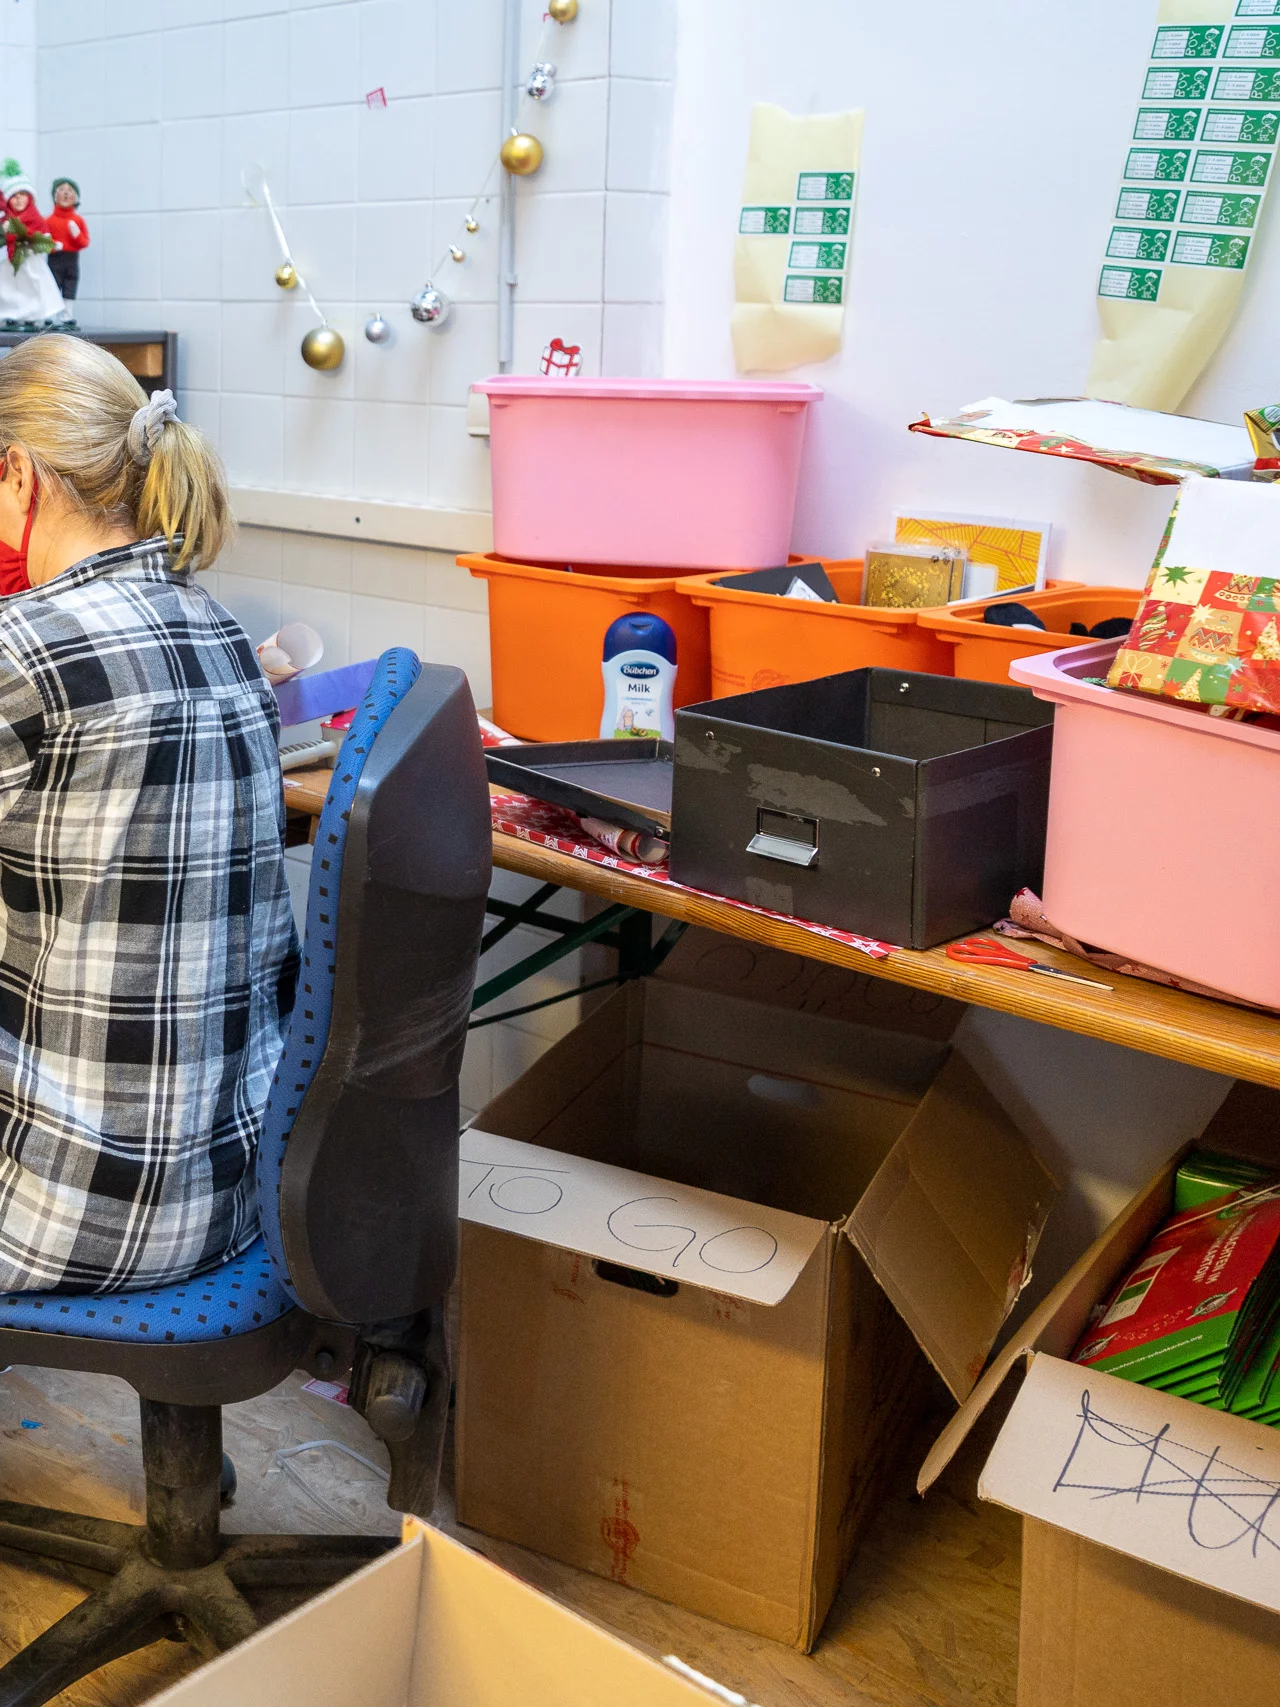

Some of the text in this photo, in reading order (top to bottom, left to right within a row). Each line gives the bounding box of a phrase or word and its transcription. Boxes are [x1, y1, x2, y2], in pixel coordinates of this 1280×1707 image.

[1185, 31, 1200, 56] BOY
[1262, 30, 1279, 56] BOY
[1175, 72, 1190, 97] BOY
[1251, 73, 1268, 98] BOY
[1165, 113, 1180, 138] BOY
[1240, 115, 1256, 141] BOY
[1156, 154, 1170, 178] BOY
[1229, 157, 1246, 182] BOY
[1146, 194, 1160, 218] BOY
[1218, 198, 1235, 223] BOY
[1137, 234, 1151, 258] BOY
[1208, 239, 1224, 264] BOY
[622, 664, 657, 676] Bübchen
[627, 683, 651, 693] Milk
[459, 1156, 570, 1215] TO
[606, 1195, 778, 1275] GO
